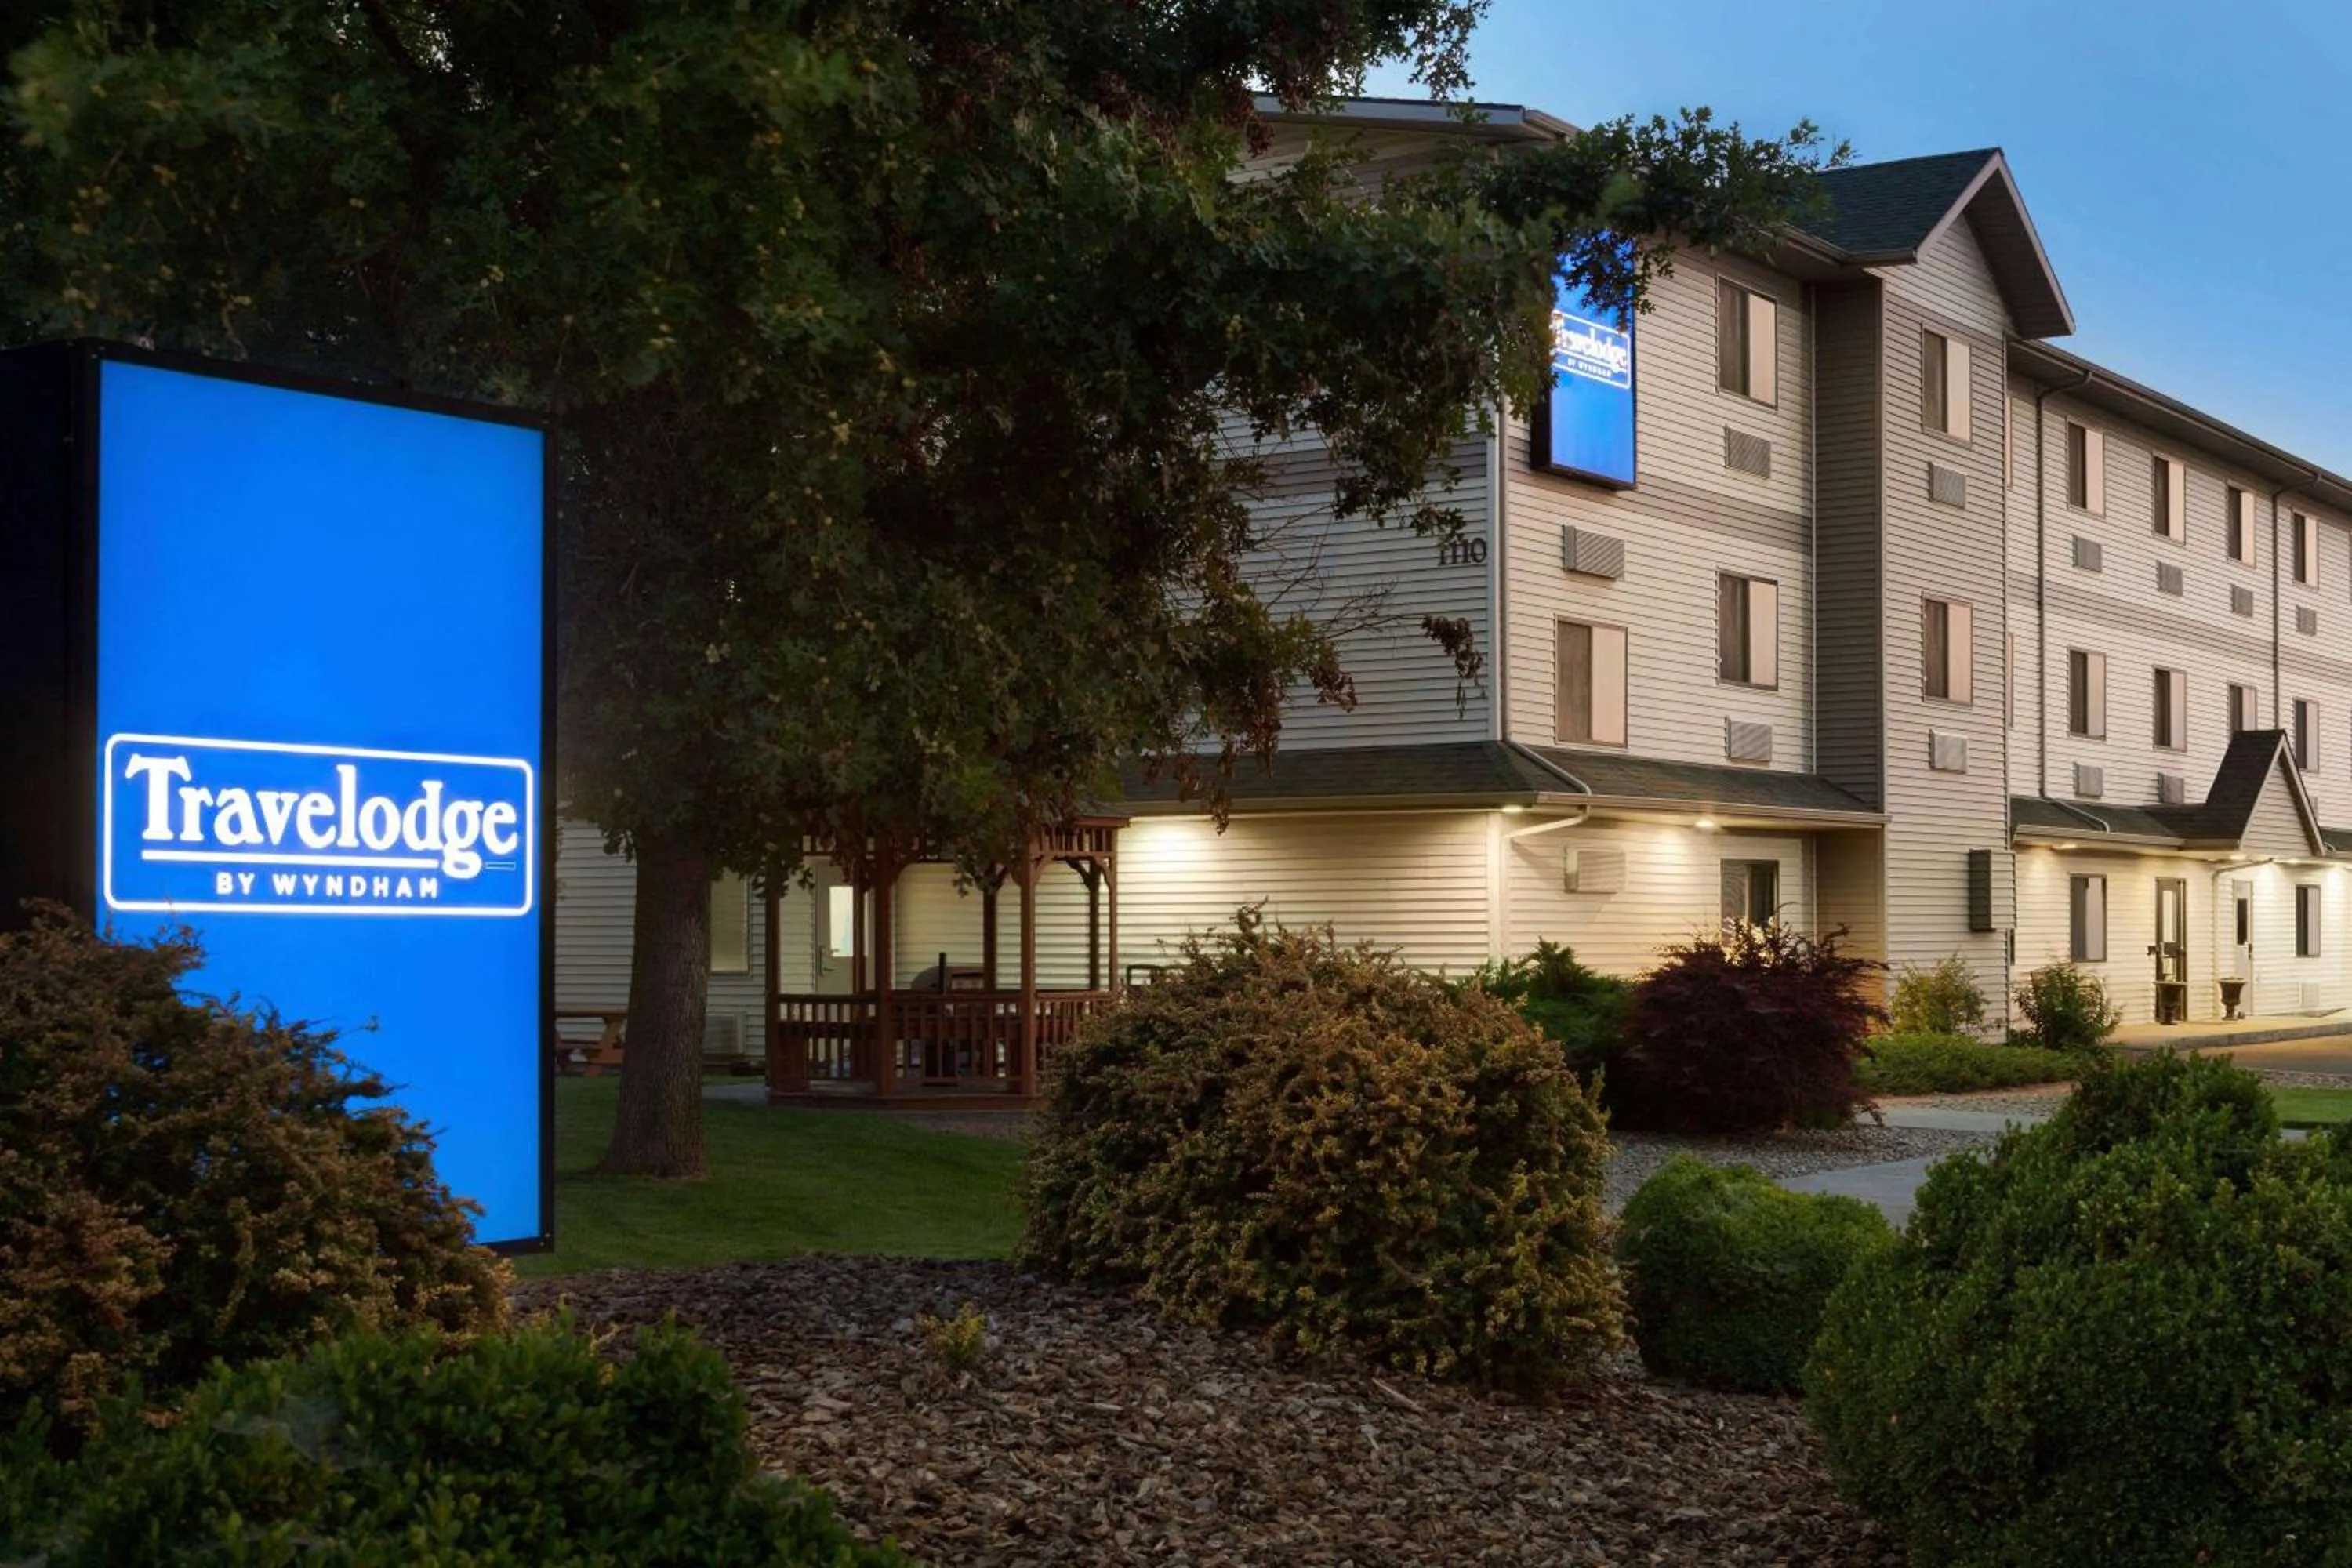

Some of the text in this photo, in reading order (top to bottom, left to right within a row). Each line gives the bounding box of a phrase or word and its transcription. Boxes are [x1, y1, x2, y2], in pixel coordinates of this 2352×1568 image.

[125, 754, 517, 879] Travelodge
[216, 872, 438, 898] BY WYNDHAM
